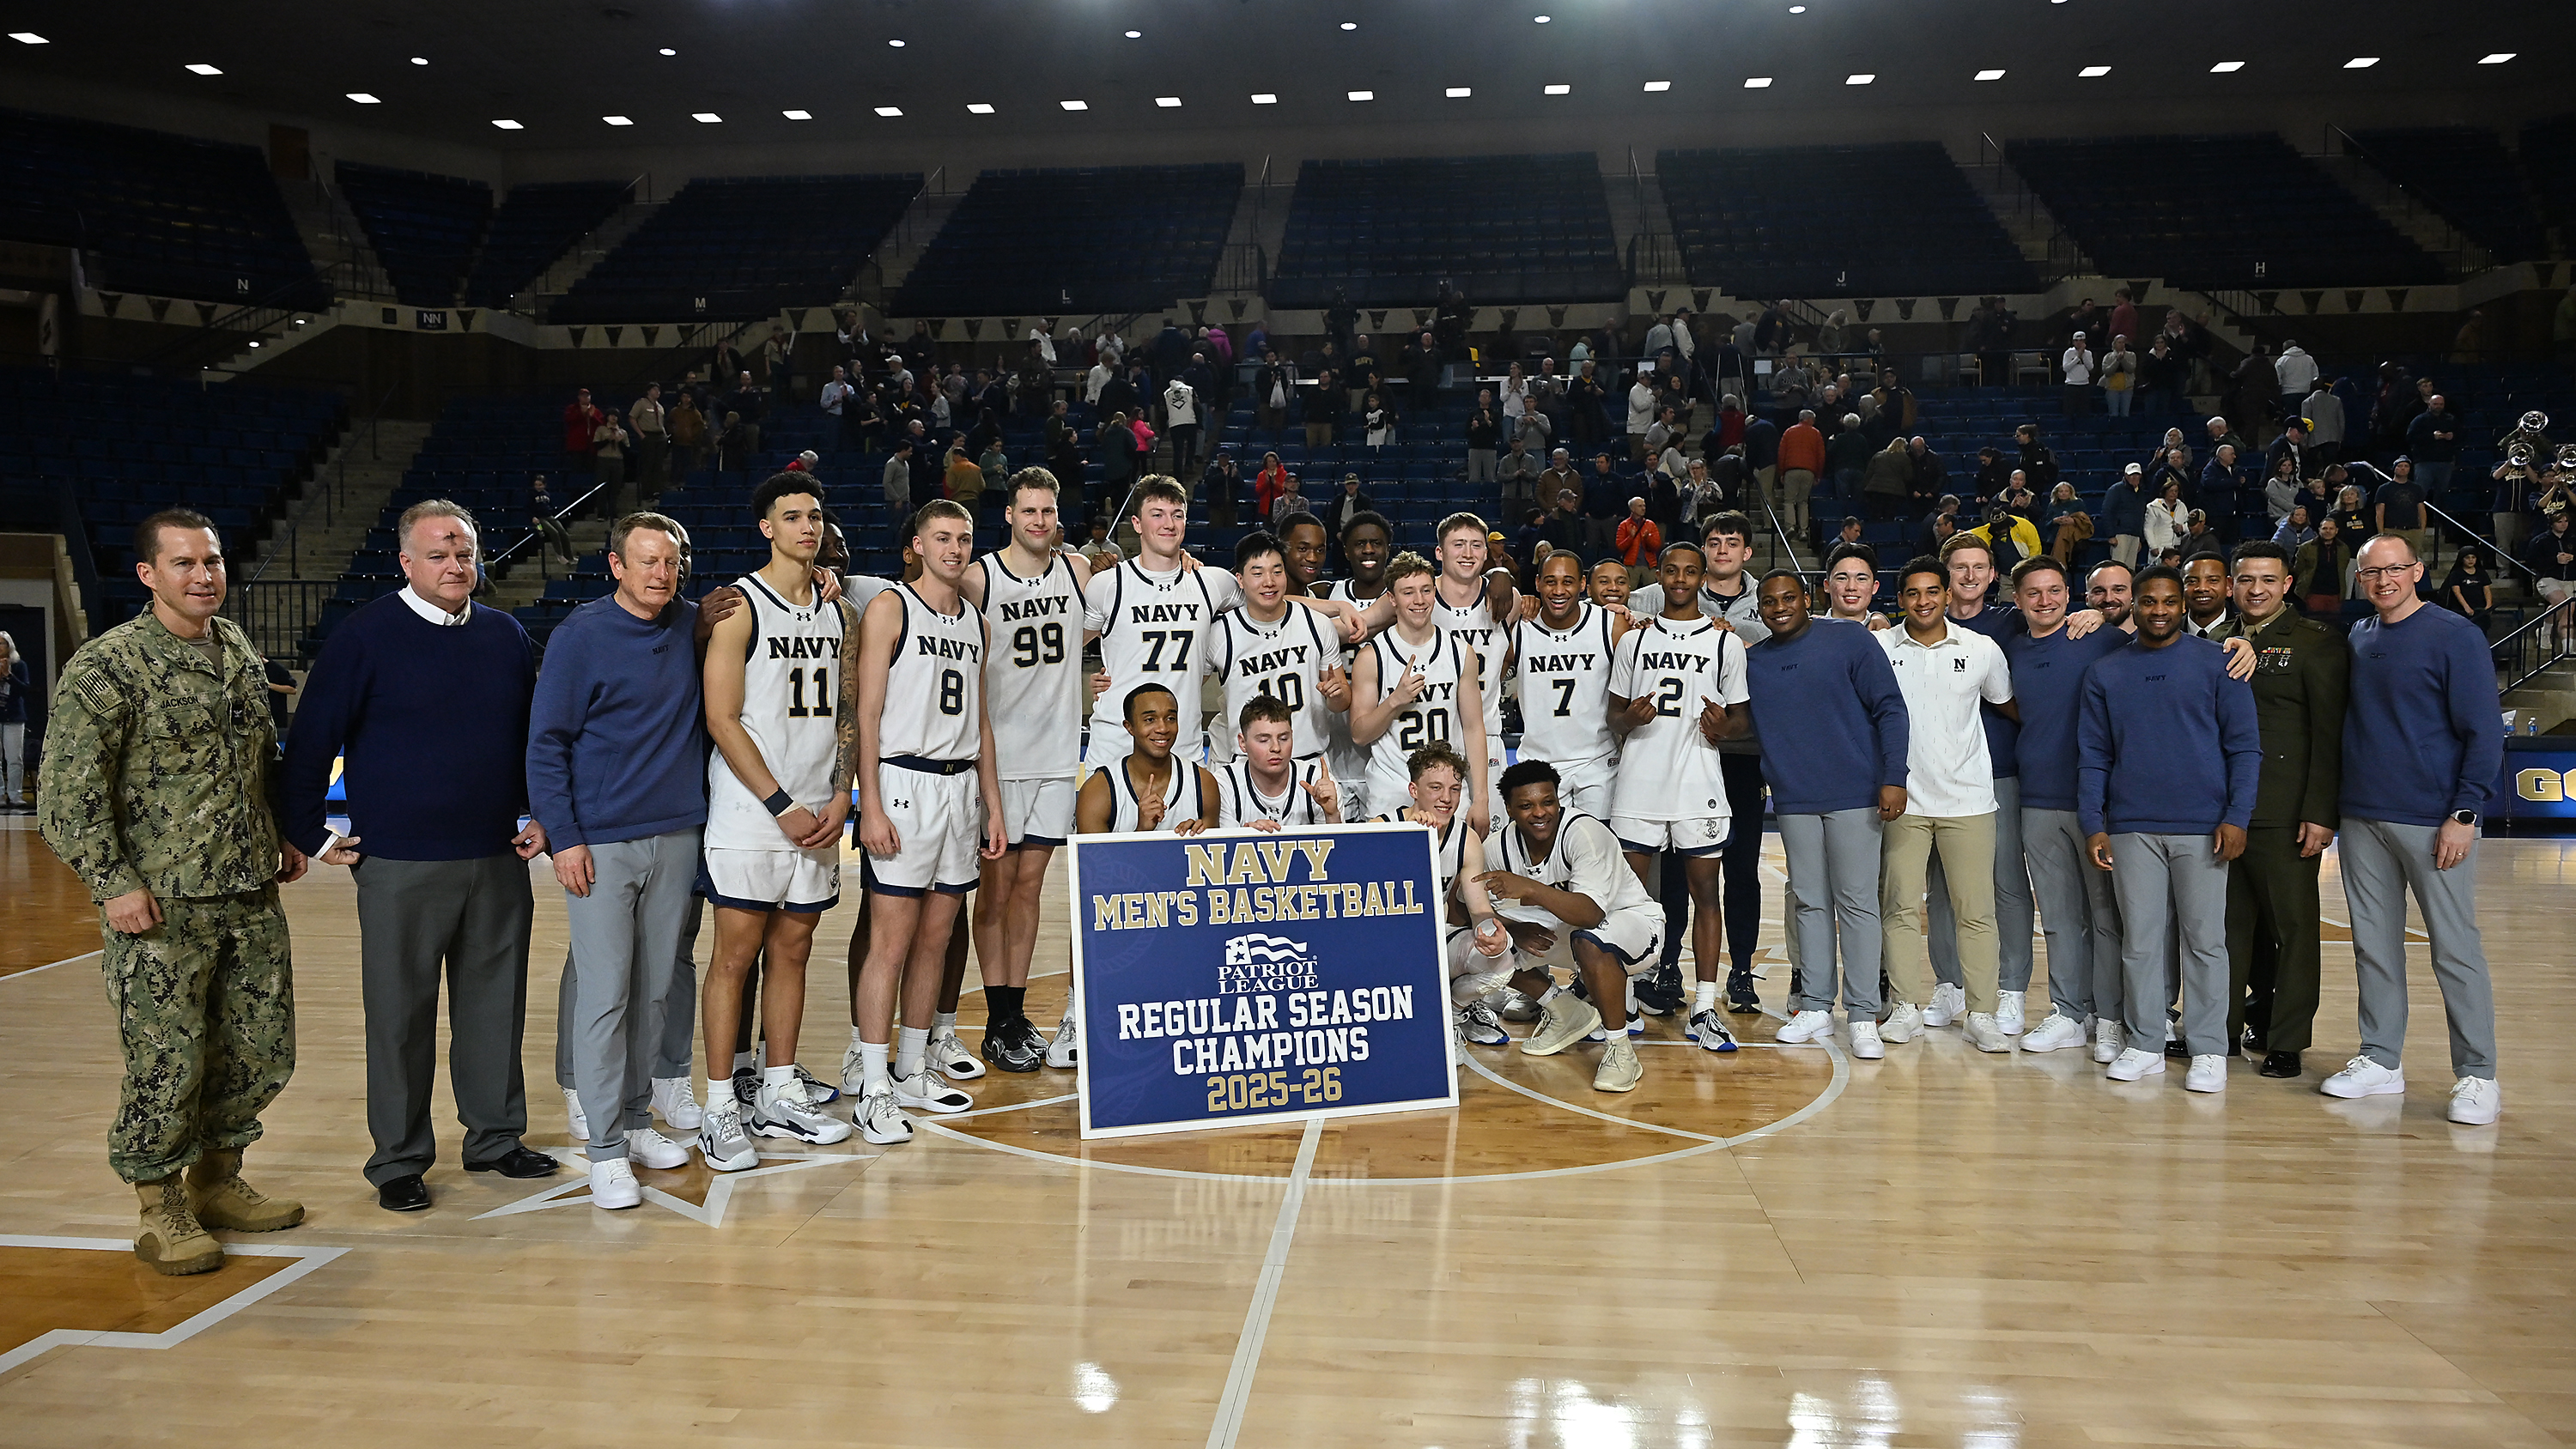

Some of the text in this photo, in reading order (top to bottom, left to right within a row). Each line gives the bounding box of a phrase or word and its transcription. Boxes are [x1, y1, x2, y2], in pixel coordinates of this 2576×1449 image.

[1837, 270, 1845, 283] J
[2255, 261, 2266, 274] H
[237, 278, 249, 291] N
[1061, 288, 1070, 300] L
[695, 297, 706, 308] M
[423, 312, 441, 324] NN
[1000, 595, 1070, 622] NAVY
[1131, 603, 1200, 624] NAVY
[652, 644, 669, 655] NAVY
[767, 636, 841, 660] NAVY
[916, 634, 980, 664] NAVY
[1012, 621, 1066, 669] 99
[1141, 629, 1194, 672] 77
[1239, 645, 1308, 677] NAVY
[1528, 653, 1595, 673] NAVY
[1642, 652, 1710, 674] NAVY
[1953, 658, 1965, 670] N
[2145, 674, 2166, 682] NAVY
[160, 696, 199, 709] JACKSON
[788, 666, 834, 718] 11
[939, 668, 963, 717] 8
[1552, 678, 1576, 718] 7
[1657, 677, 1684, 718] 2
[1399, 707, 1449, 751] 20
[945, 763, 954, 773] N
[2516, 767, 2576, 802] G
[1184, 839, 1334, 888] NAVY
[1093, 881, 1425, 931] MEN'S BASKETBALL
[1218, 961, 1318, 981] PATRIOT
[1218, 974, 1319, 995] LEAGUE
[1118, 985, 1413, 1040] REGULAR SEASON
[1173, 1026, 1370, 1076] CHAMPIONS
[1207, 1066, 1342, 1113] 2025-26
